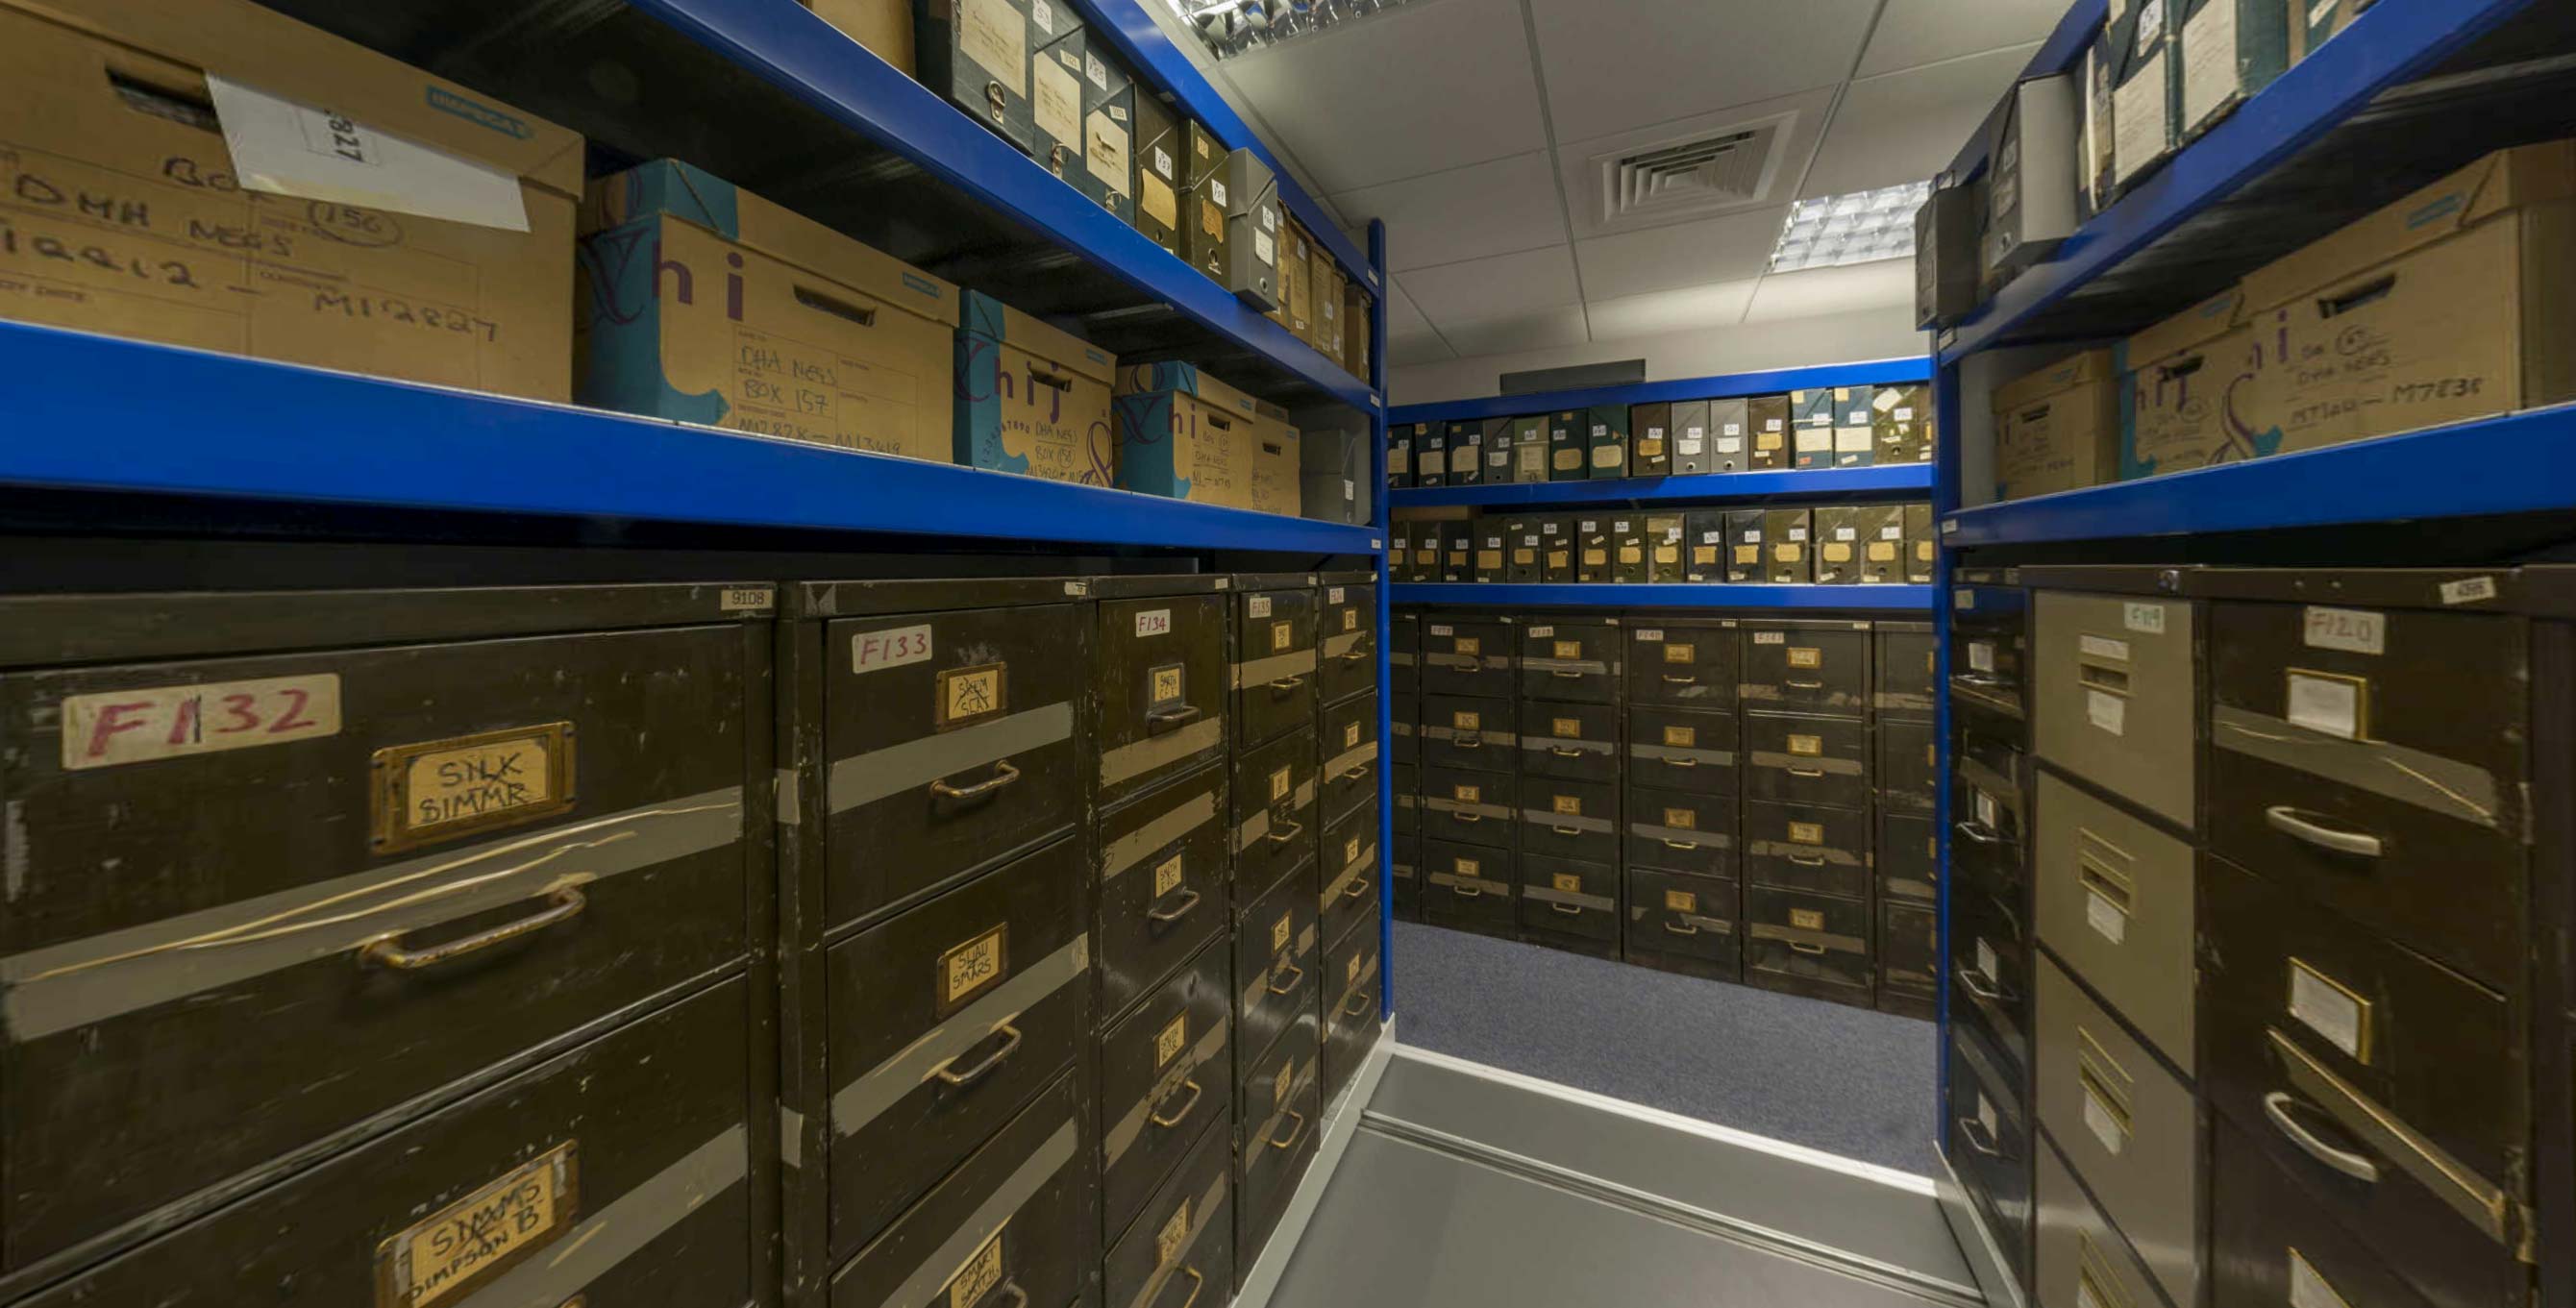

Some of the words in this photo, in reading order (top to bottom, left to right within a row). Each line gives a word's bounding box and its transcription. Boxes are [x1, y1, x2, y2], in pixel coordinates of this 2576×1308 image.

[795, 388, 830, 414] 157
[731, 591, 765, 605] 9108
[1139, 616, 1167, 632] F134
[860, 633, 928, 665] F133
[88, 688, 315, 756] F132
